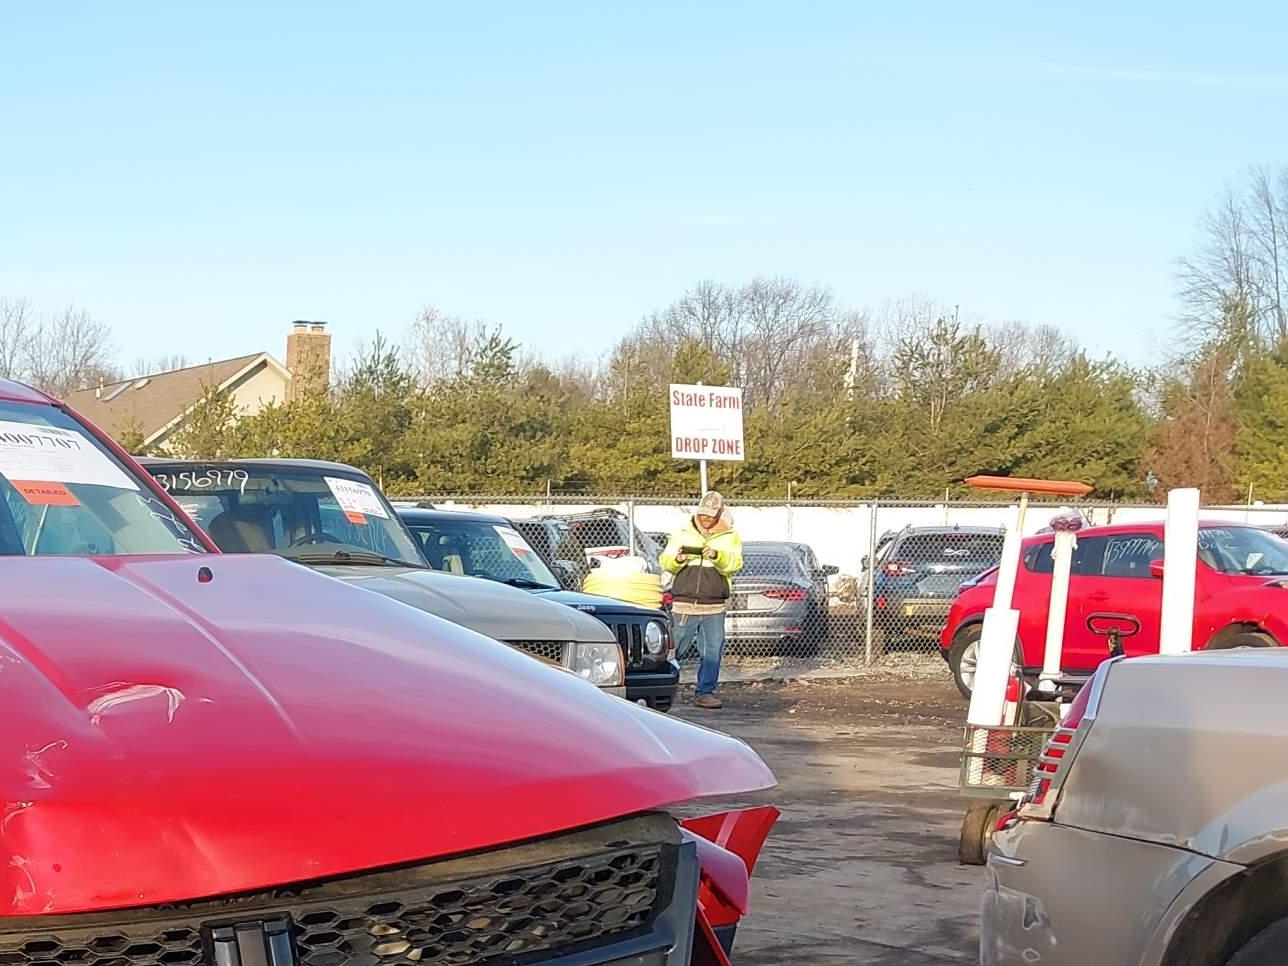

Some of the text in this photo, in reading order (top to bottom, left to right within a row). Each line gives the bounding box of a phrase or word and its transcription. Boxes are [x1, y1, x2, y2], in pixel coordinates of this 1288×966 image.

[672, 389, 740, 410] State Farm
[675, 436, 741, 455] DROP ZONE
[23, 488, 66, 496] DETAILED
[153, 469, 249, 496] 3156979
